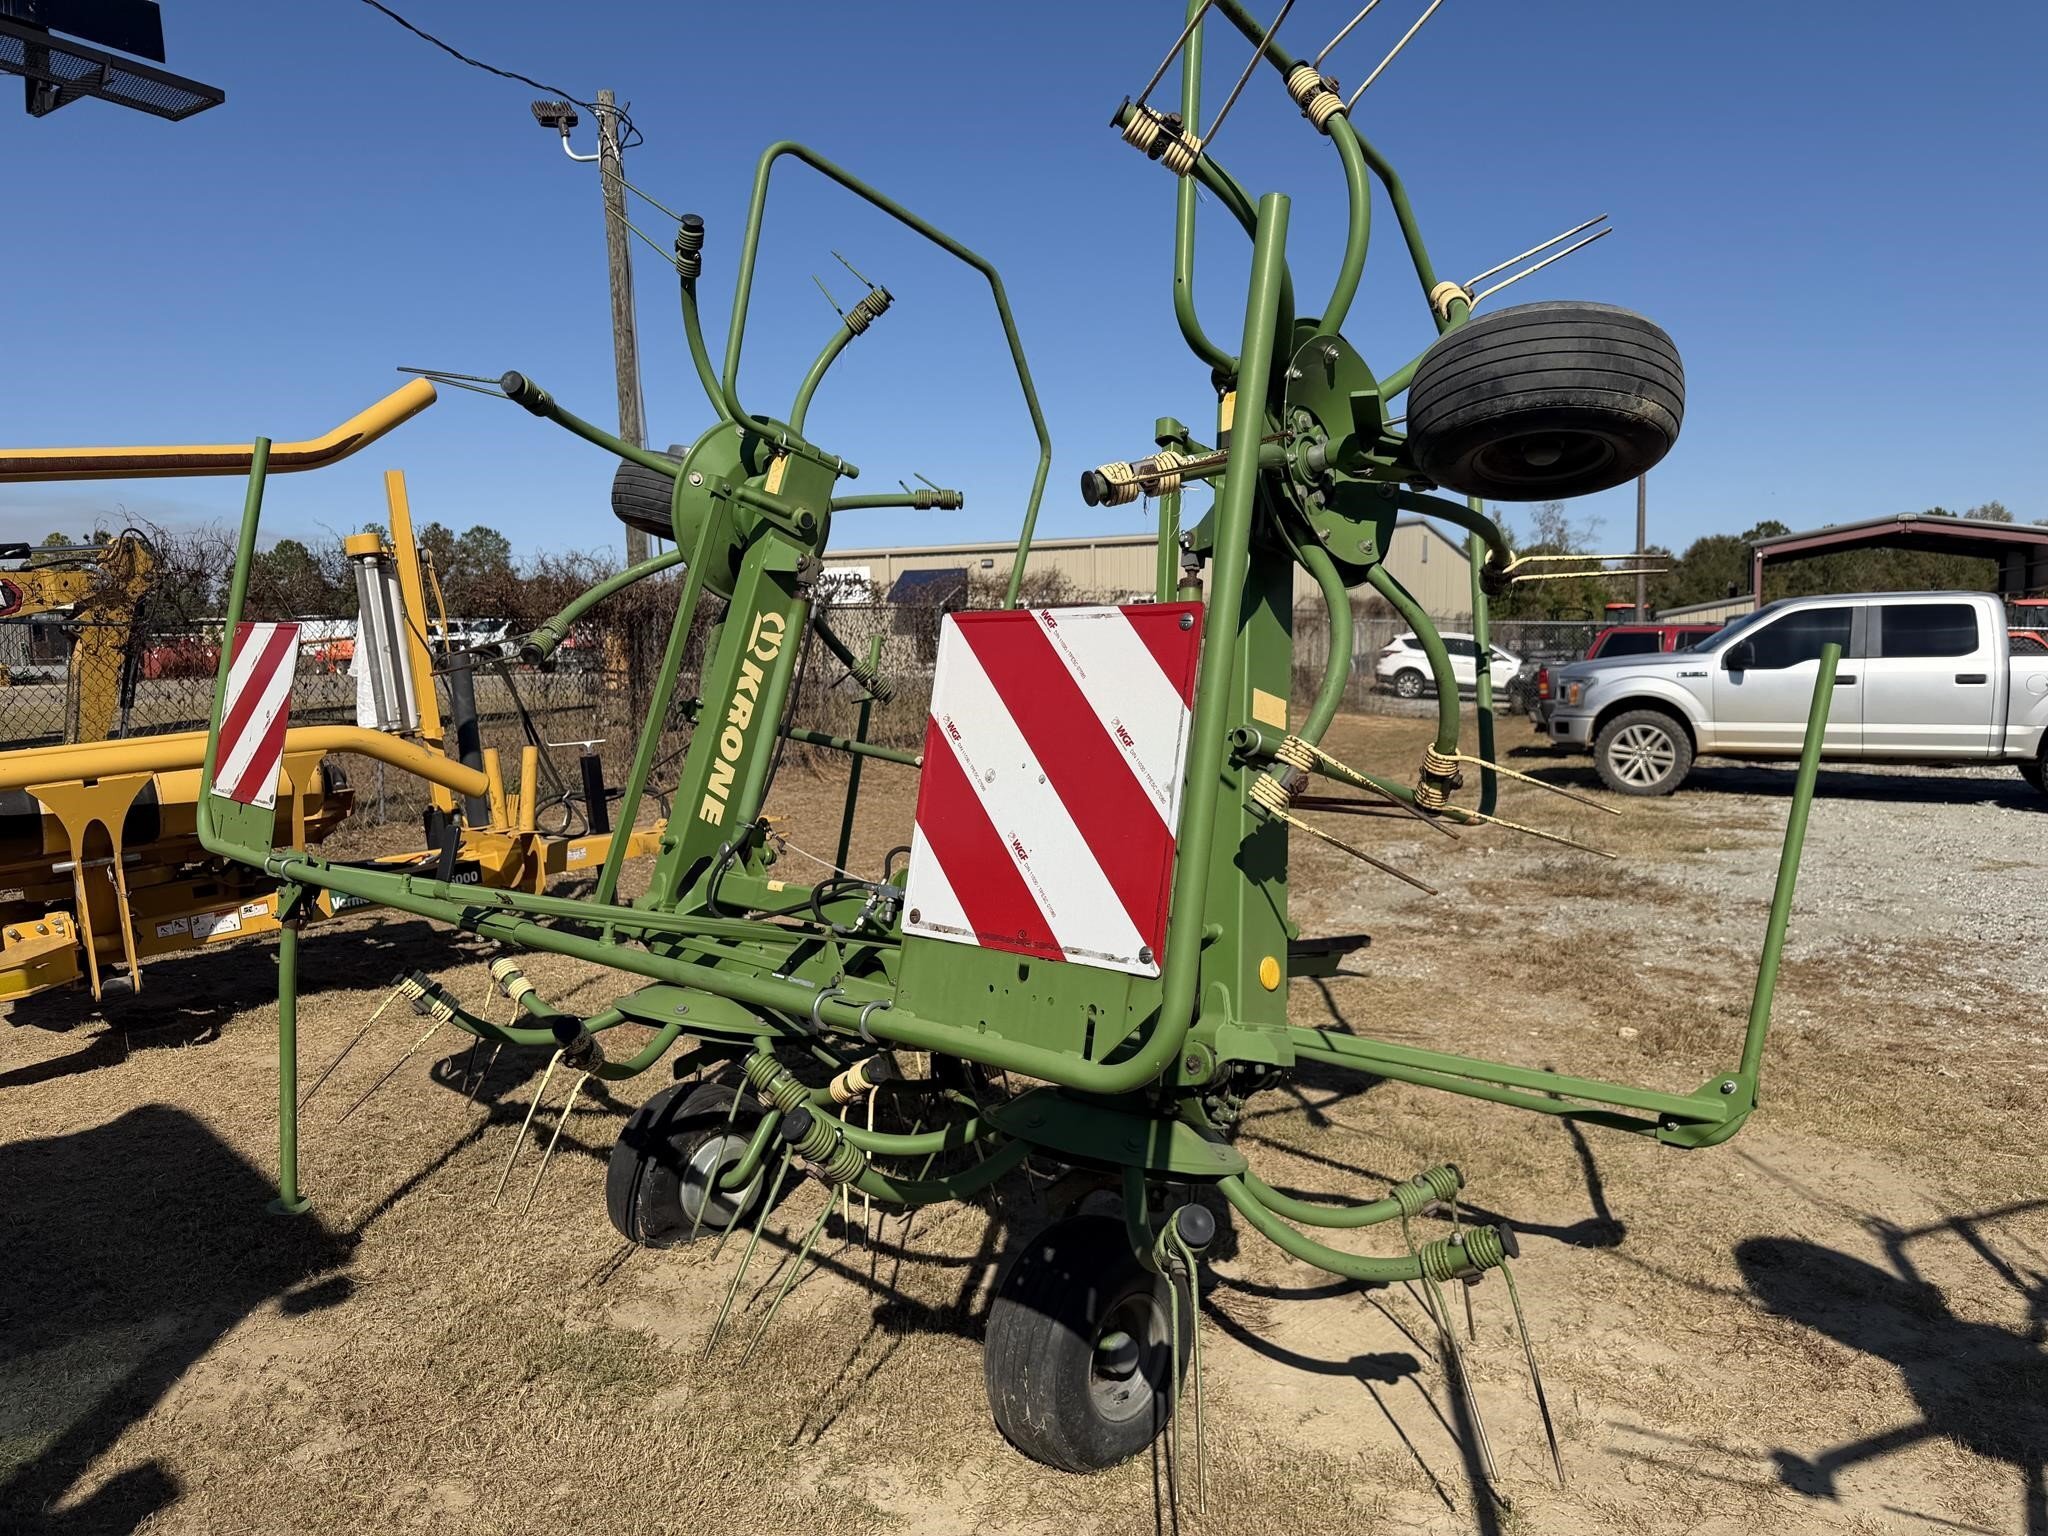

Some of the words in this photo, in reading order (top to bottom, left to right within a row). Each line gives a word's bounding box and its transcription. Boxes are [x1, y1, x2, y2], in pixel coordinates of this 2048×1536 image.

[817, 573, 863, 587] OWER
[1041, 609, 1058, 629] WGF
[947, 721, 962, 741] WGF
[1116, 725, 1134, 748] WGF
[699, 658, 764, 826] KRONE
[1012, 838, 1029, 861] WGF
